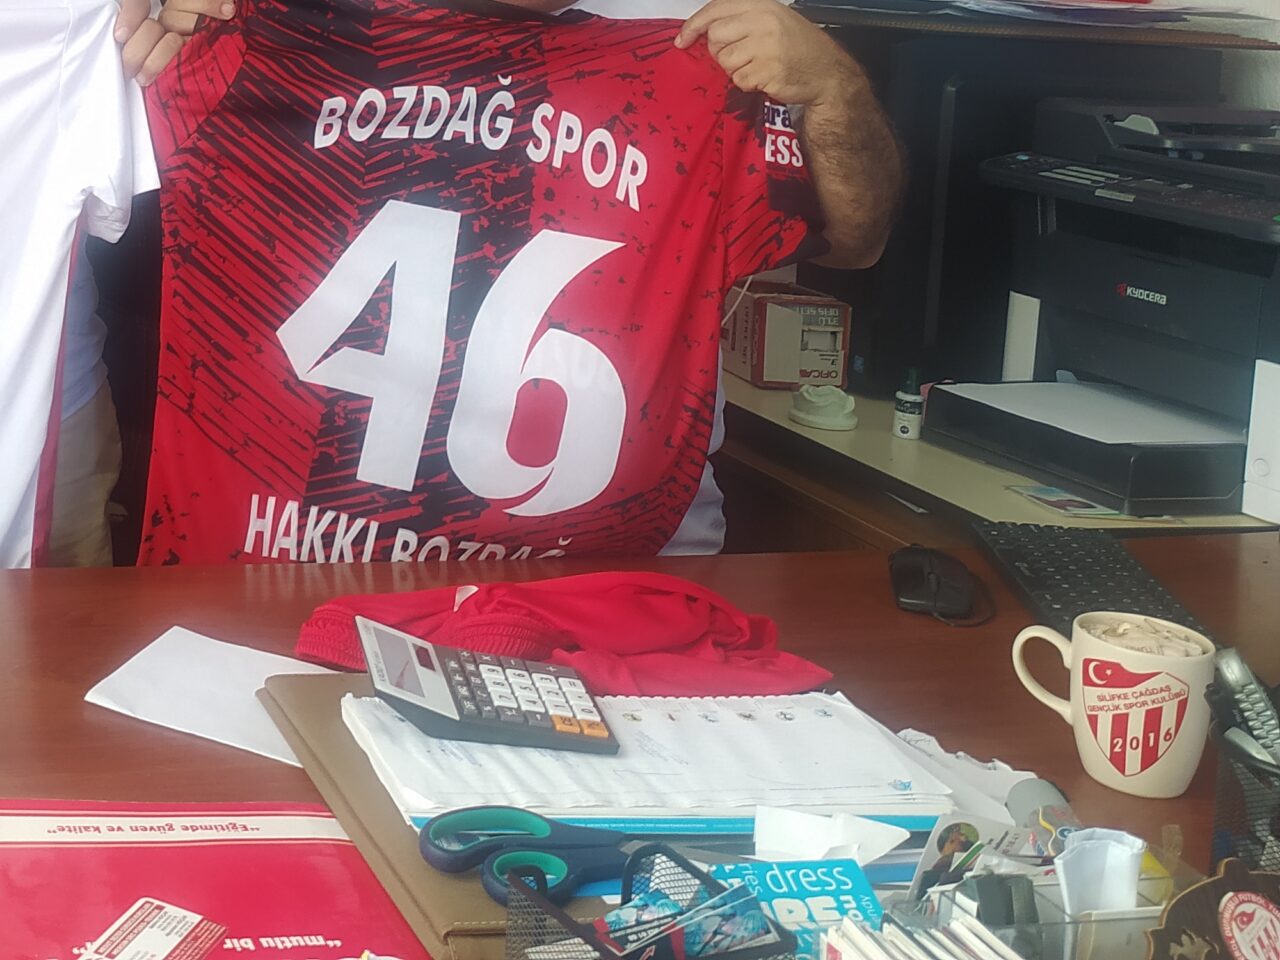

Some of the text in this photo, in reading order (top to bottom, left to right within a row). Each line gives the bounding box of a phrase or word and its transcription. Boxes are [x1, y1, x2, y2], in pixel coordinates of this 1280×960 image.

[313, 74, 649, 212] BOZDAĞ SPOR
[1126, 286, 1167, 305] KYOCERA
[276, 199, 628, 516] 46
[243, 494, 380, 564] HAKKI
[1088, 689, 1186, 713] GENÇLİK SPOR KULÜBÜ
[1097, 685, 1172, 702] SİLİFKE ÇAĞDAŞ
[1113, 727, 1173, 752] 2016
[106, 825, 124, 833] ve
[129, 822, 175, 834] güven
[765, 863, 853, 893] dress
[223, 937, 254, 951] bir
